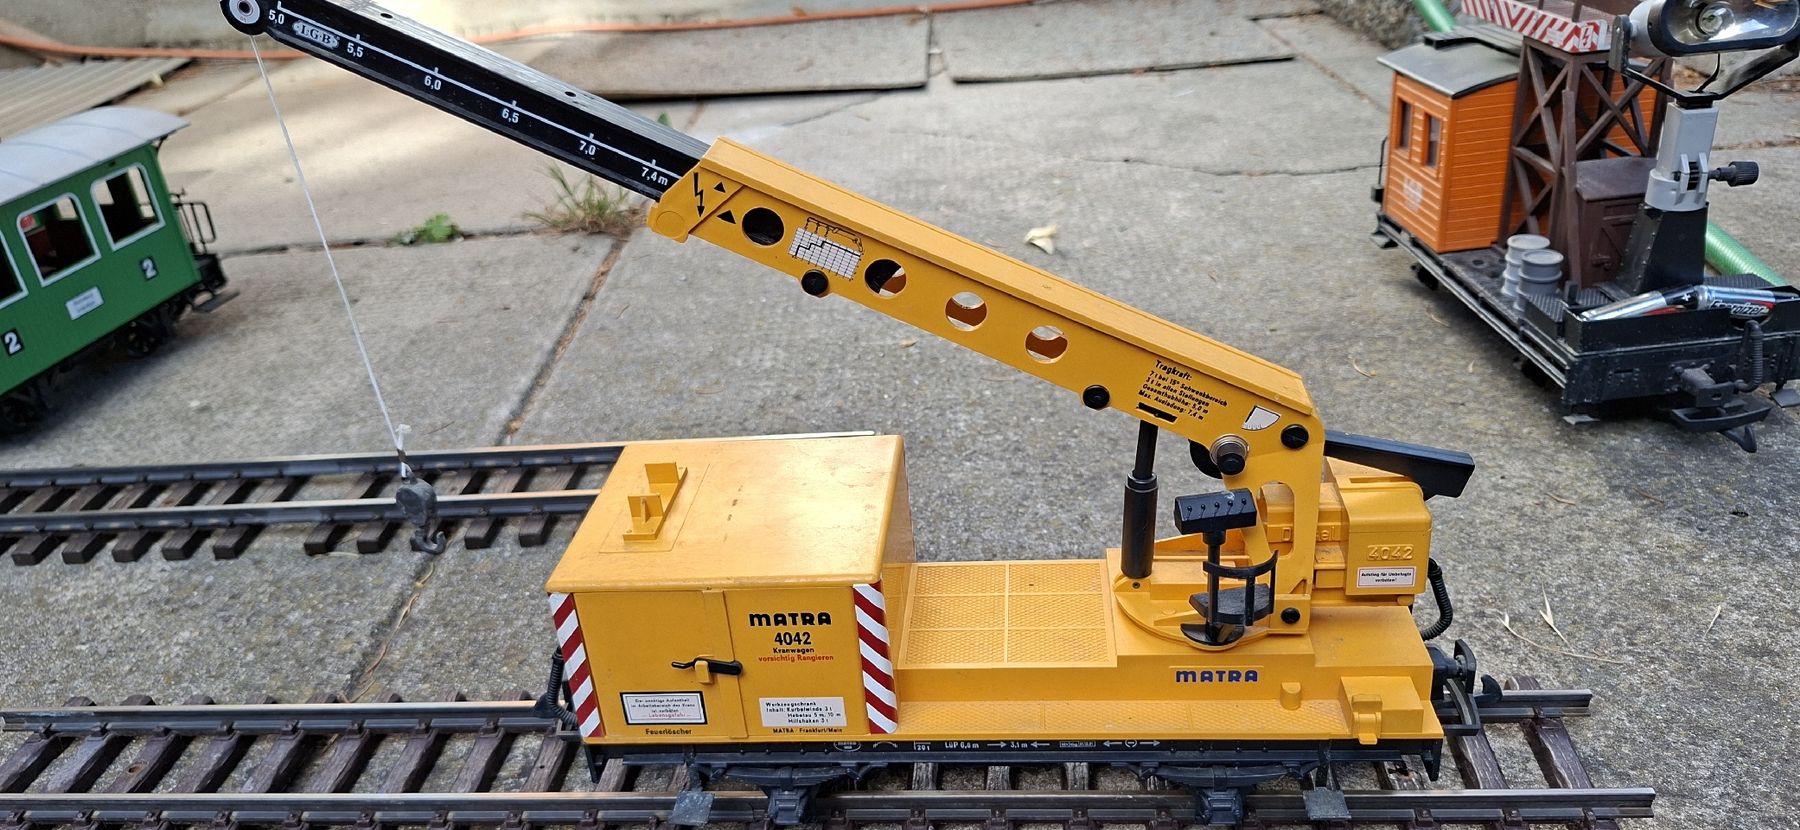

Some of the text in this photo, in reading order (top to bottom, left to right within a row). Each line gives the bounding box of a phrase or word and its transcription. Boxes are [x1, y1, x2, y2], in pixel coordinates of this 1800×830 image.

[268, 9, 284, 25] 5,0
[347, 42, 363, 58] 5,5
[424, 75, 441, 90] 6,0
[502, 108, 519, 124] 6,5
[579, 140, 596, 156] 7,0
[142, 258, 157, 279] 2
[4, 332, 22, 355] 2
[1156, 360, 1192, 381] Tragkraft:
[1179, 390, 1210, 407] Stellungen
[1180, 383, 1228, 407] Schwenkbereich
[1369, 546, 1413, 560] 4042
[749, 612, 831, 626] MATRA
[774, 632, 811, 645] 4042
[797, 654, 834, 662] Rangieren
[1176, 670, 1258, 682] MATRA
